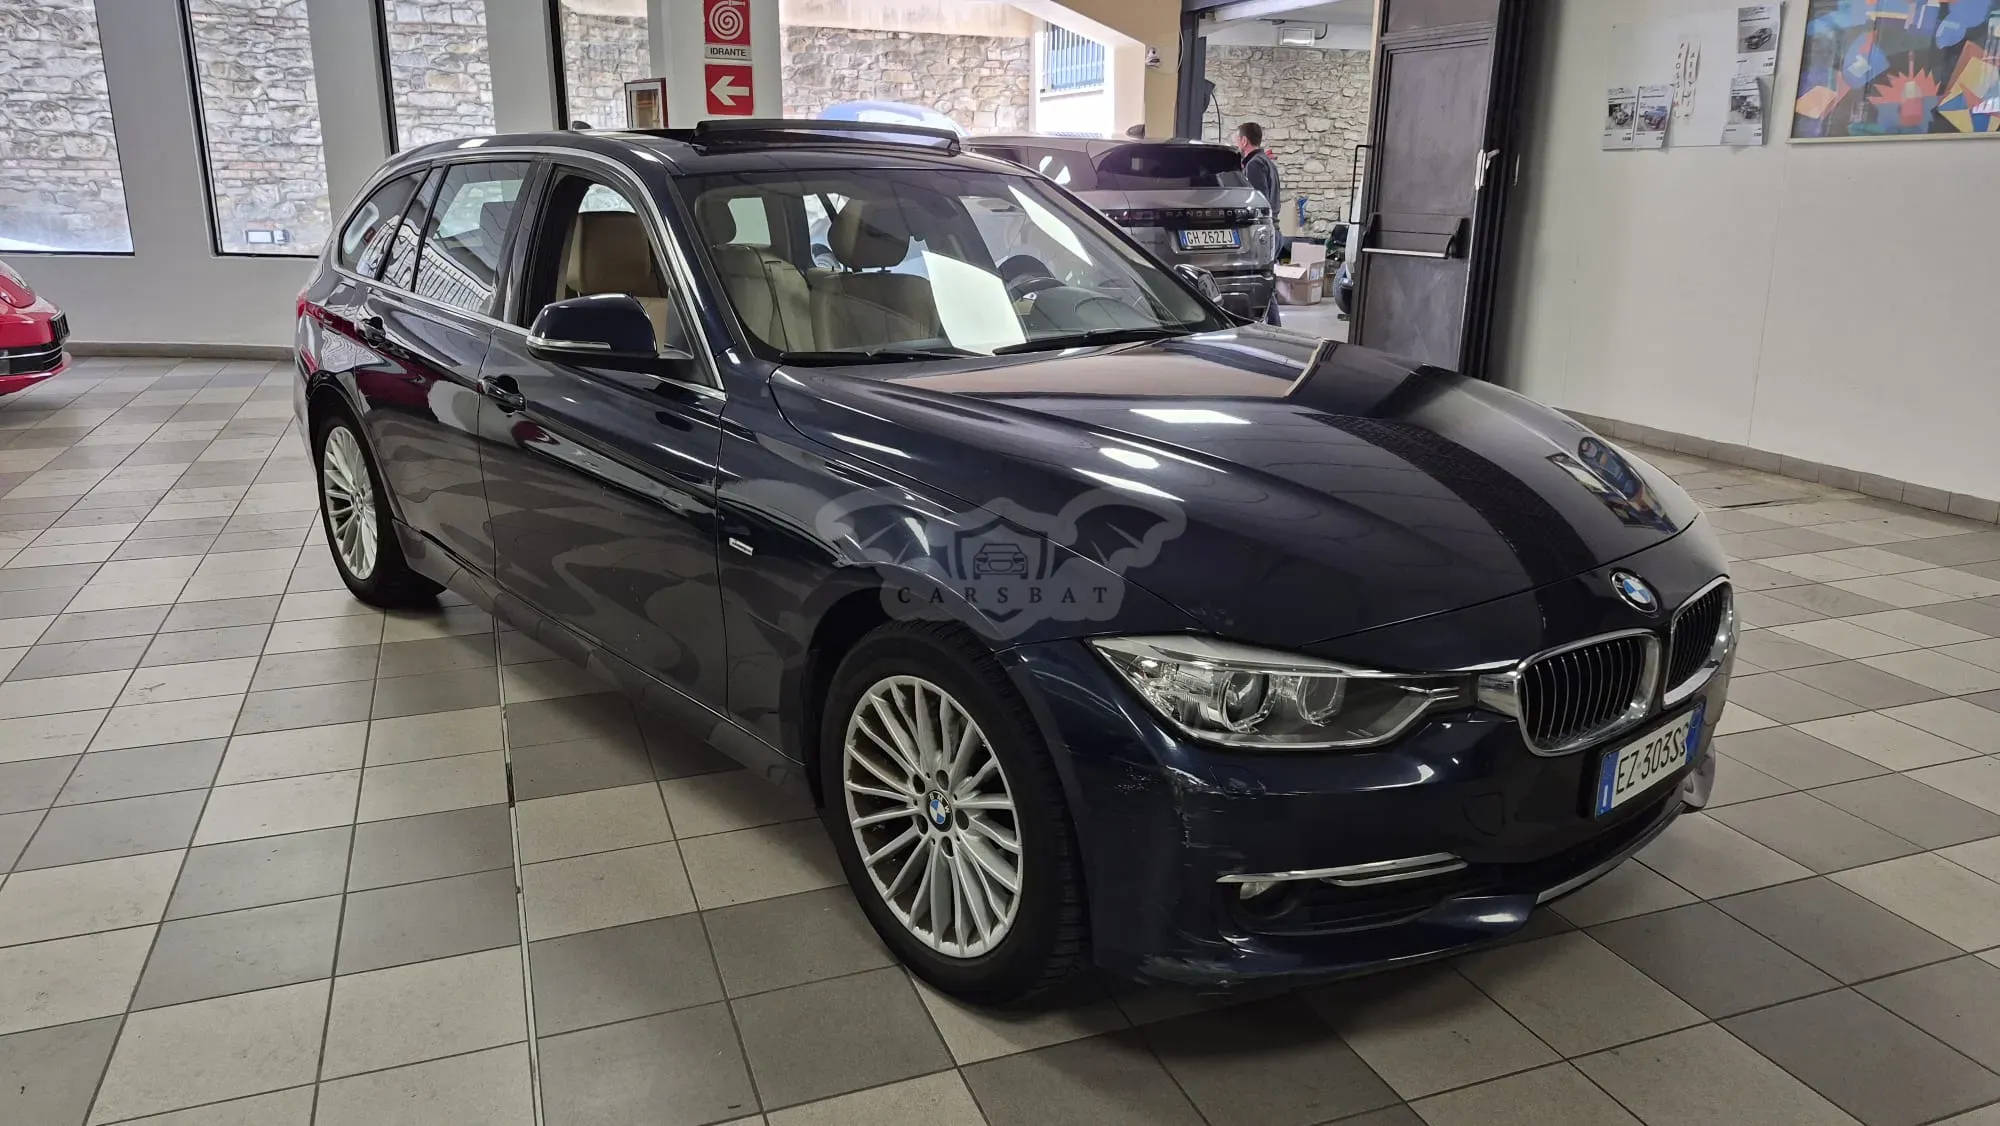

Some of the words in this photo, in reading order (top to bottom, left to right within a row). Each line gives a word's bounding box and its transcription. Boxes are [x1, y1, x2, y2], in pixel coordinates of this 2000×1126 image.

[710, 47, 747, 57] IDRANTE
[1186, 231, 1200, 244] GH
[1201, 230, 1233, 244] 262ZJ
[1616, 749, 1640, 795] EZ
